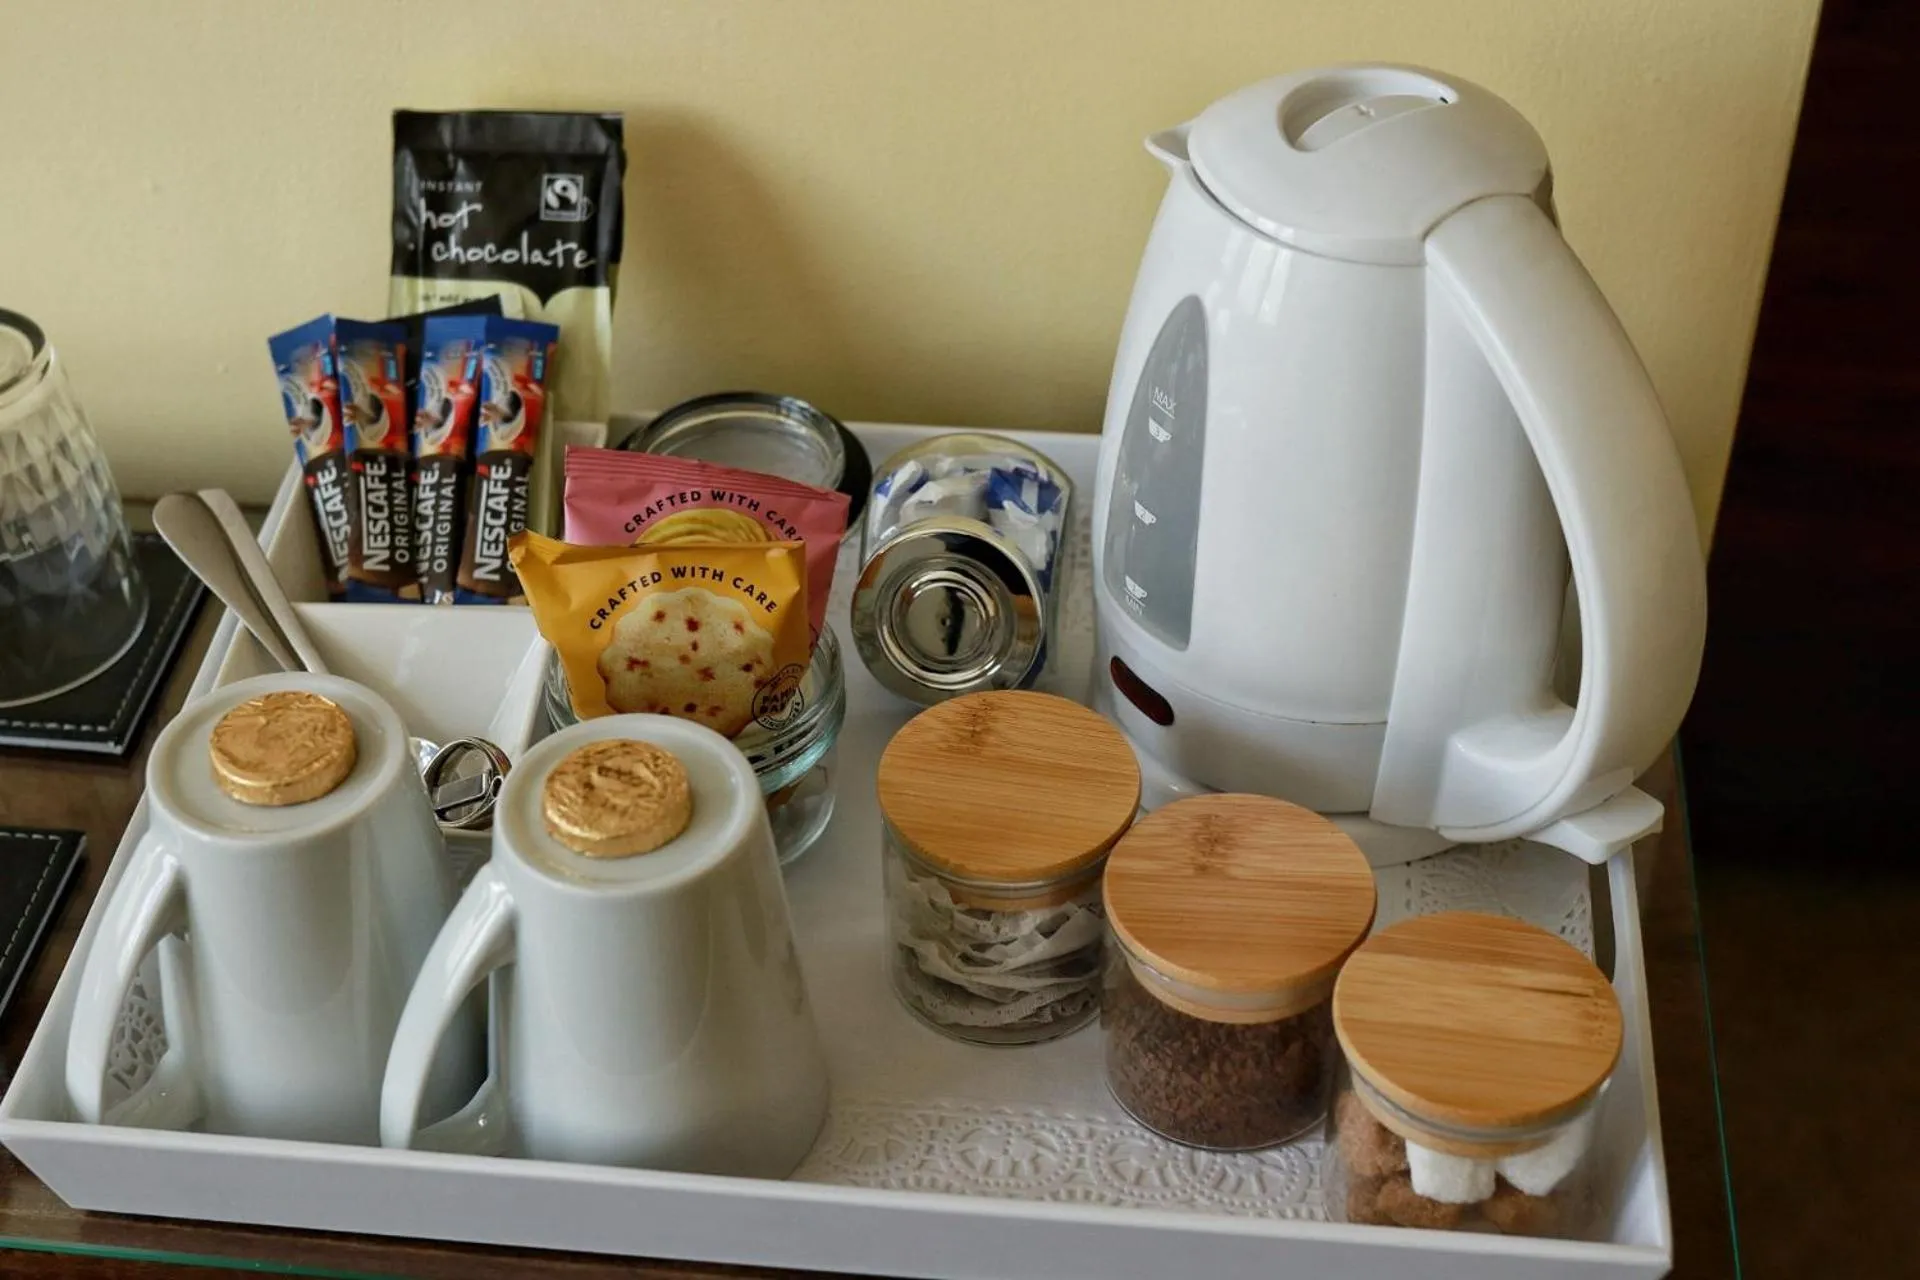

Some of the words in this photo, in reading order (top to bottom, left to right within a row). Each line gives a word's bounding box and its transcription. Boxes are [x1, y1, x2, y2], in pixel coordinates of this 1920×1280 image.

[420, 181, 482, 193] INSTANT
[419, 197, 483, 230] hot
[431, 230, 596, 269] chocolate
[1153, 386, 1176, 416] MAX
[392, 469, 411, 563] ORIGINAL
[433, 473, 457, 573] ORIGINAL
[507, 474, 530, 573] OGINAL
[624, 490, 702, 534] CRAFTED
[711, 490, 760, 512] WITH
[590, 571, 662, 630] CRAFTED
[671, 565, 725, 581] WITH
[732, 577, 777, 613] CARE
